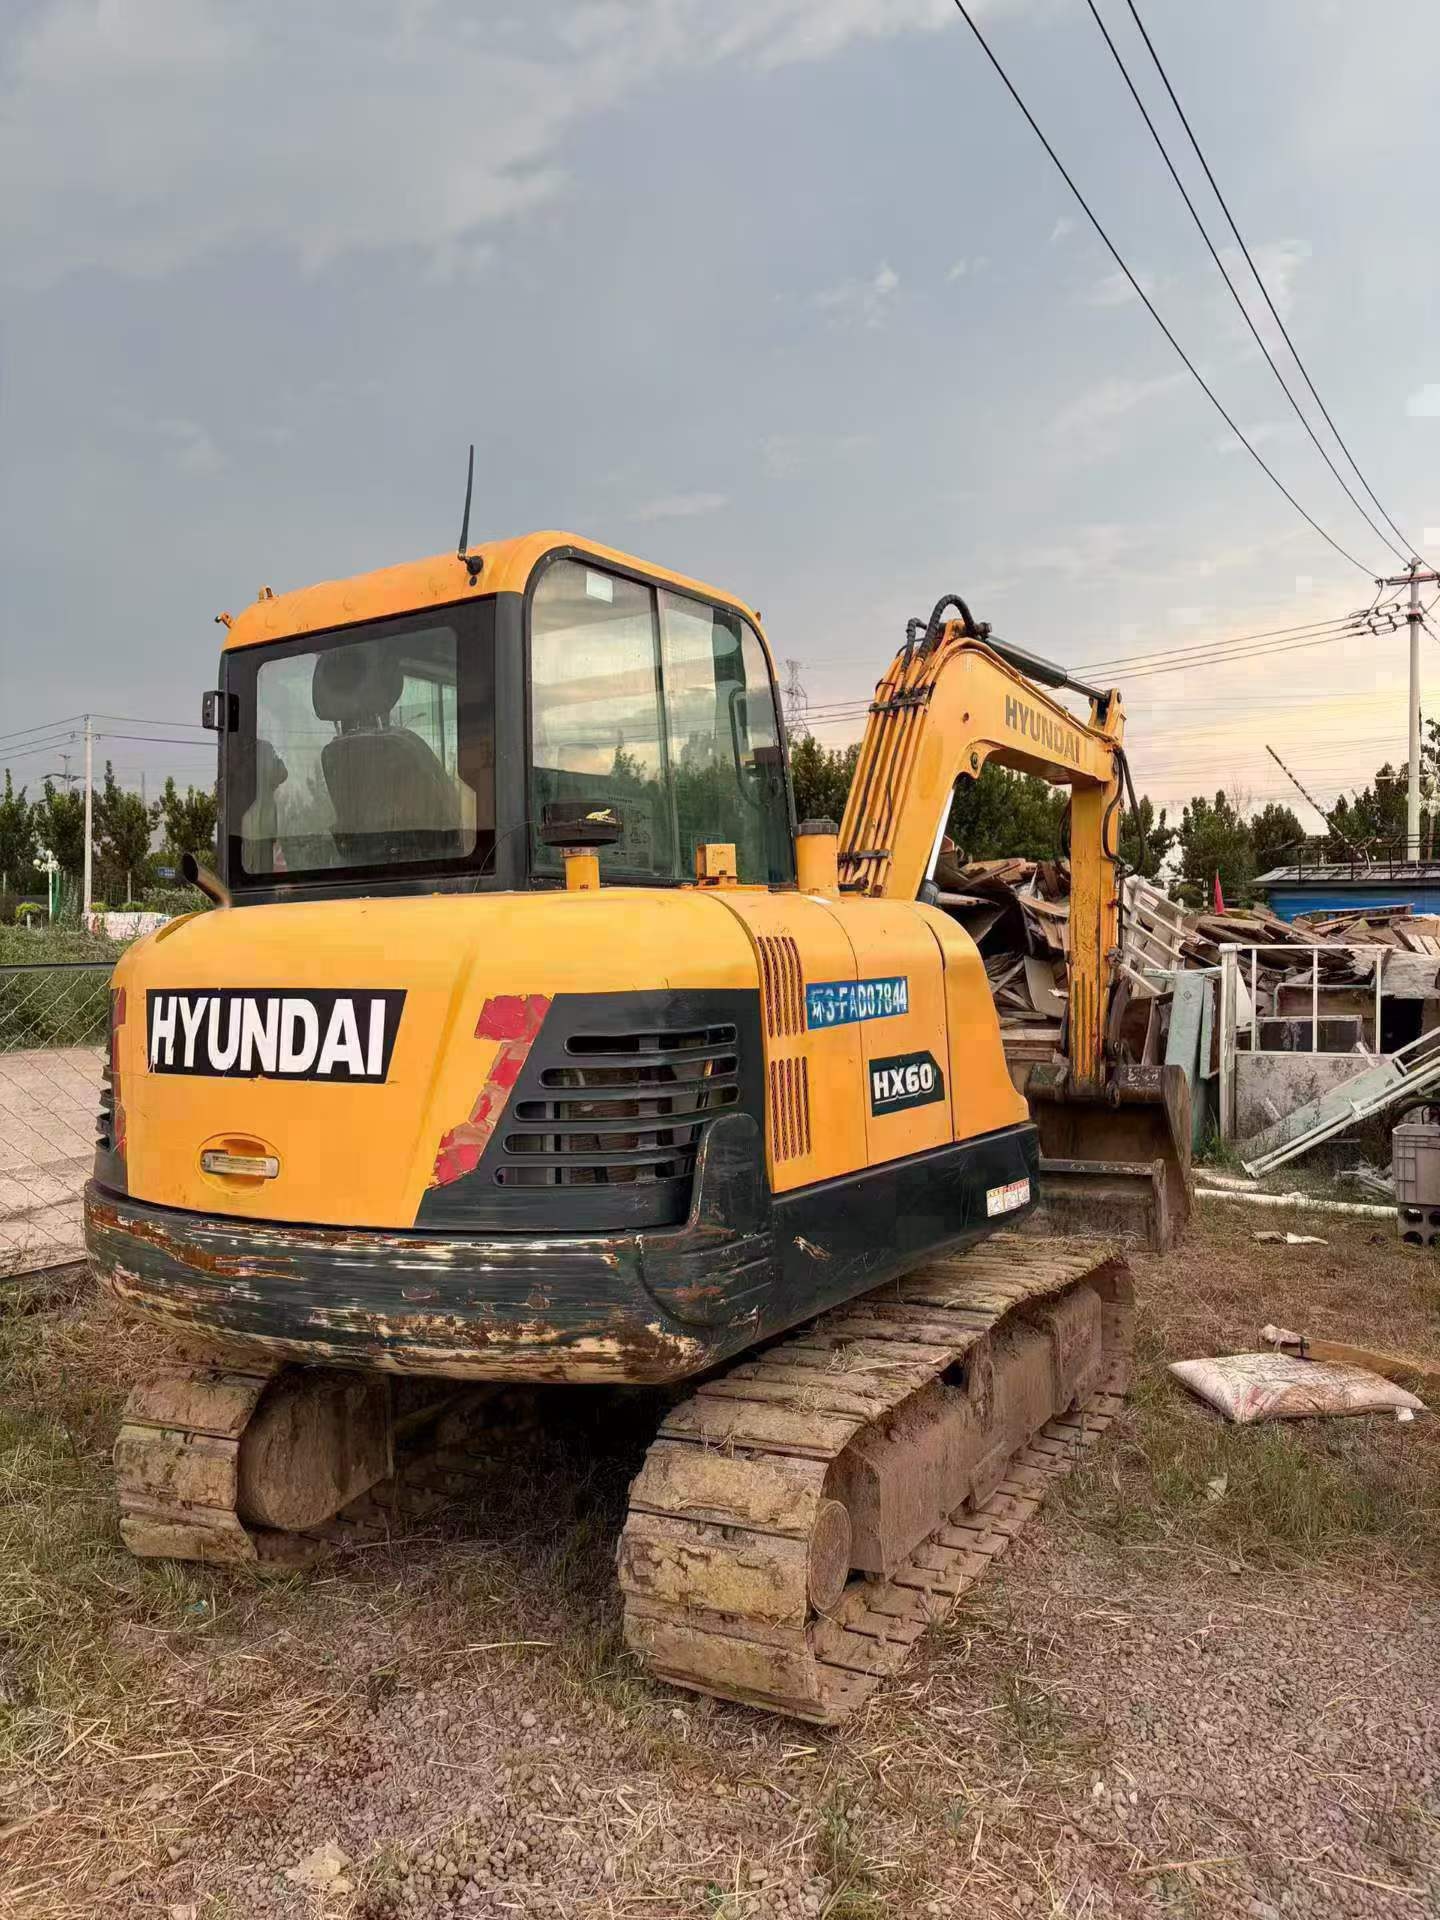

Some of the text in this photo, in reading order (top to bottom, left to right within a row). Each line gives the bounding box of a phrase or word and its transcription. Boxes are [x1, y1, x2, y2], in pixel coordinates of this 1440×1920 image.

[1005, 694, 1080, 764] HYUNDAI
[151, 996, 386, 1075] HYUNDAI
[873, 1063, 933, 1099] HX60
